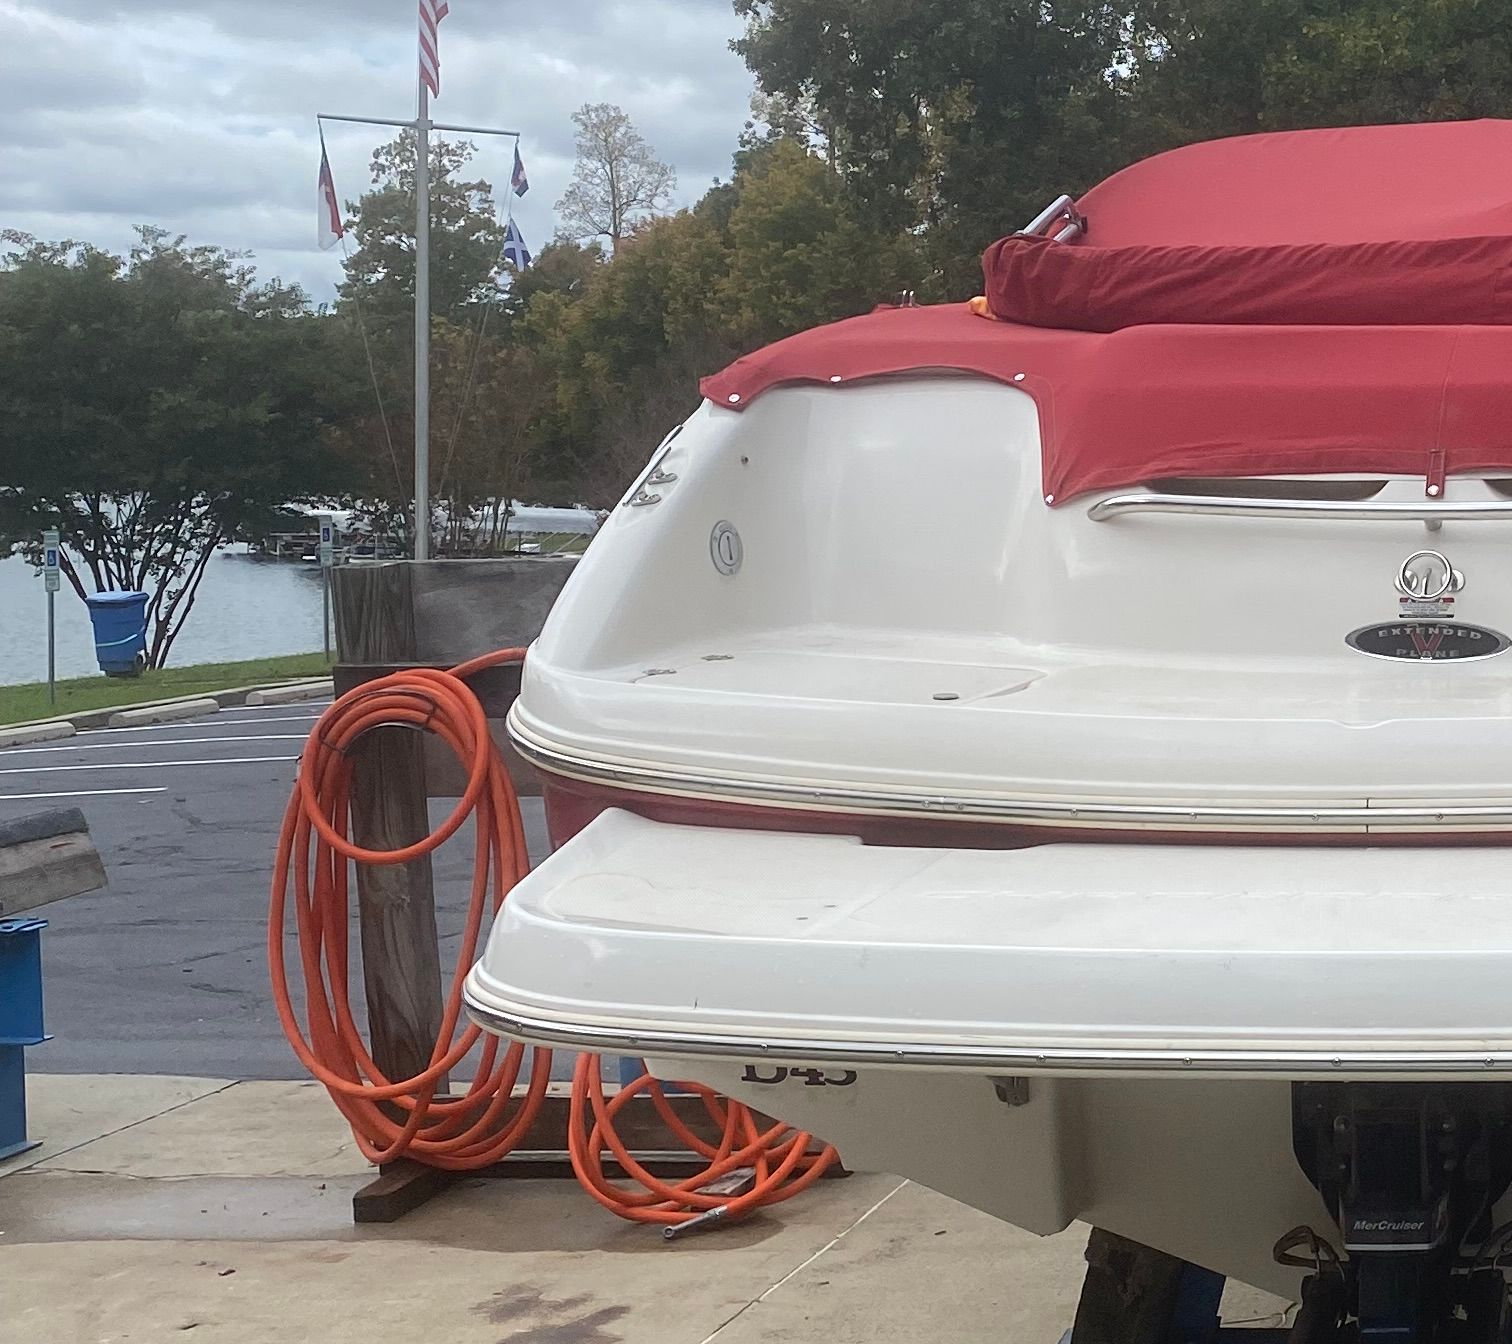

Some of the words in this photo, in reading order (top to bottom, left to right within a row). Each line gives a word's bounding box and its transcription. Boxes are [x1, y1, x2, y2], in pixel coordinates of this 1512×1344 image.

[1378, 627, 1483, 640] EXTENDED
[1395, 648, 1461, 658] PLANE
[1353, 1220, 1425, 1231] MerCruiser
